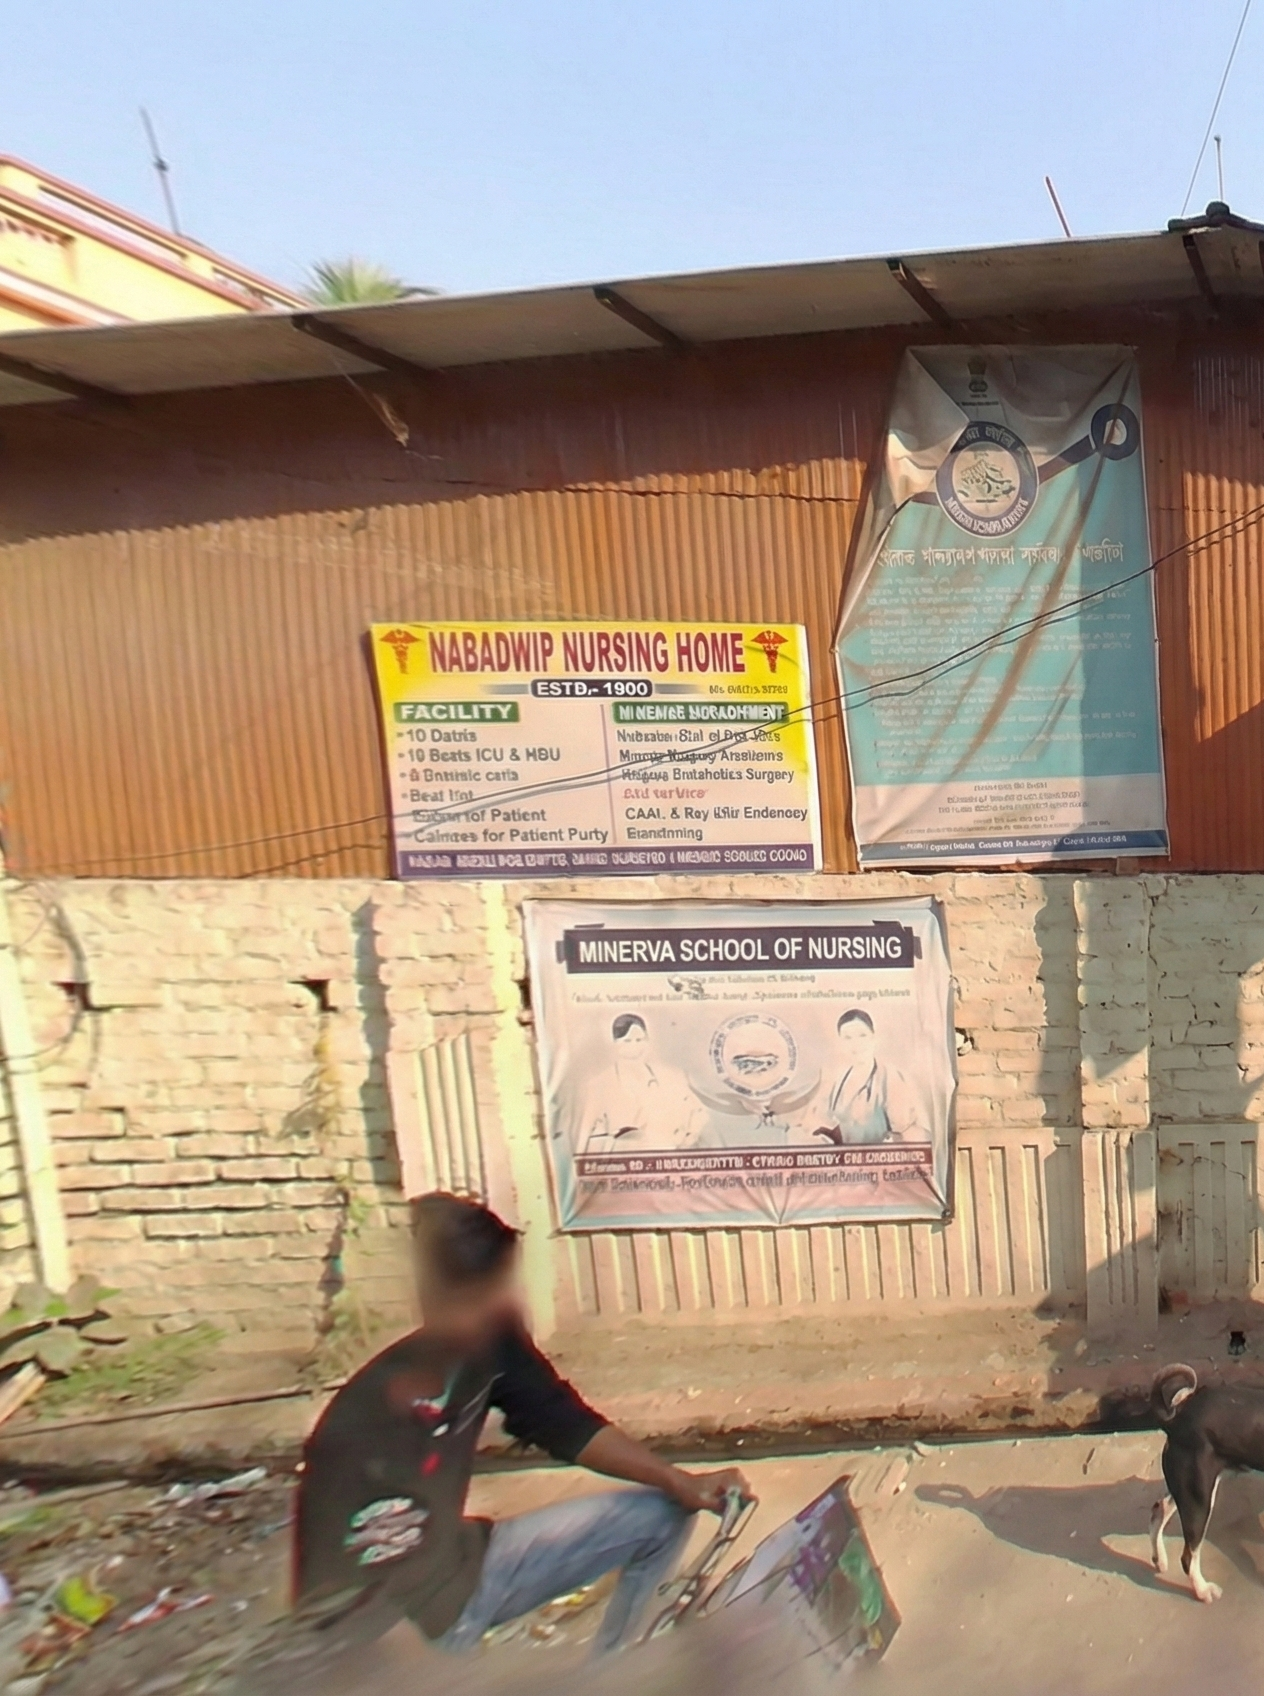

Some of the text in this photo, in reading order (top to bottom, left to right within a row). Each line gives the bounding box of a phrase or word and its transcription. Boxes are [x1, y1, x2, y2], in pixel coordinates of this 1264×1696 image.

[429, 631, 746, 673] NABADWIP NURSING HOME
[603, 681, 648, 696] 1900
[400, 703, 512, 720] FACILITY
[476, 747, 504, 762] ICU
[508, 748, 521, 762] &
[491, 808, 547, 822] Patient
[483, 828, 506, 842] for
[509, 828, 565, 842] Patient
[579, 936, 902, 963] MINERVA SCHOOL OF NURSING
